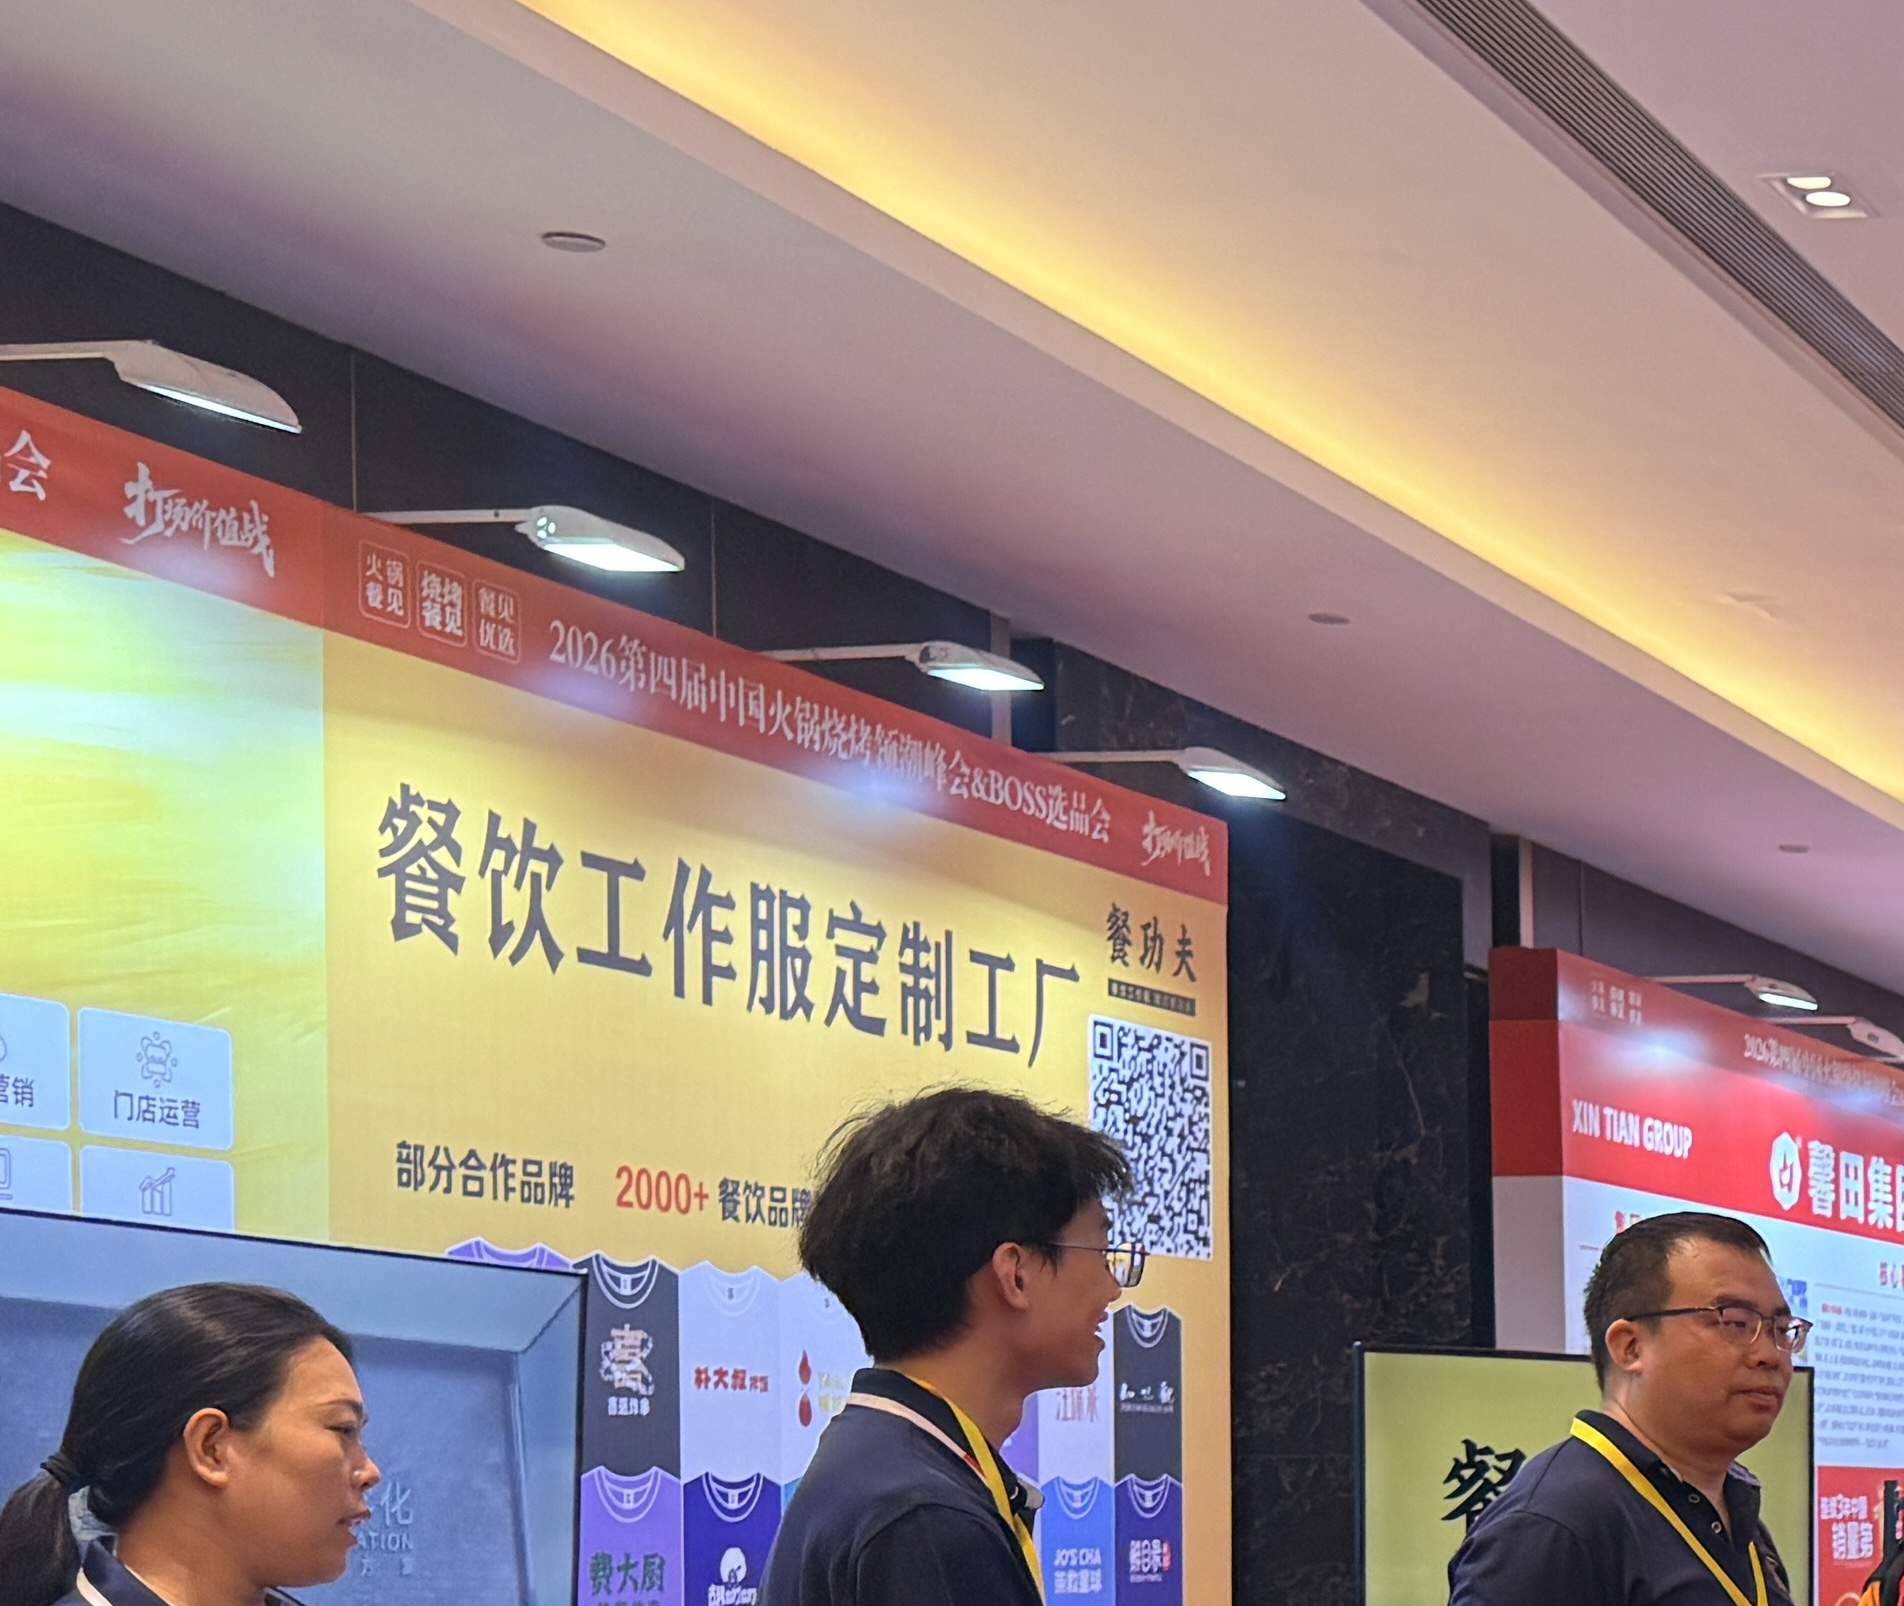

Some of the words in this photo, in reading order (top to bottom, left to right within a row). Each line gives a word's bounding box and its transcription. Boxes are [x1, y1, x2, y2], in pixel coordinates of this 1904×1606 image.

[3, 429, 52, 502] 会
[366, 553, 404, 588] 火锅
[377, 782, 1081, 1068] 餐饮工作服定制工厂
[1106, 902, 1197, 983] 餐功夫
[113, 1089, 201, 1130] 门店运营
[1572, 1099, 1600, 1138] XIN
[1603, 1107, 1641, 1149] TIAN
[1642, 1114, 1693, 1160] GROUP
[396, 1140, 575, 1209] 部分合作品牌
[615, 1165, 710, 1215] 2000+
[718, 1177, 811, 1229] 餐饮品牌
[590, 1552, 665, 1596] 费大厨
